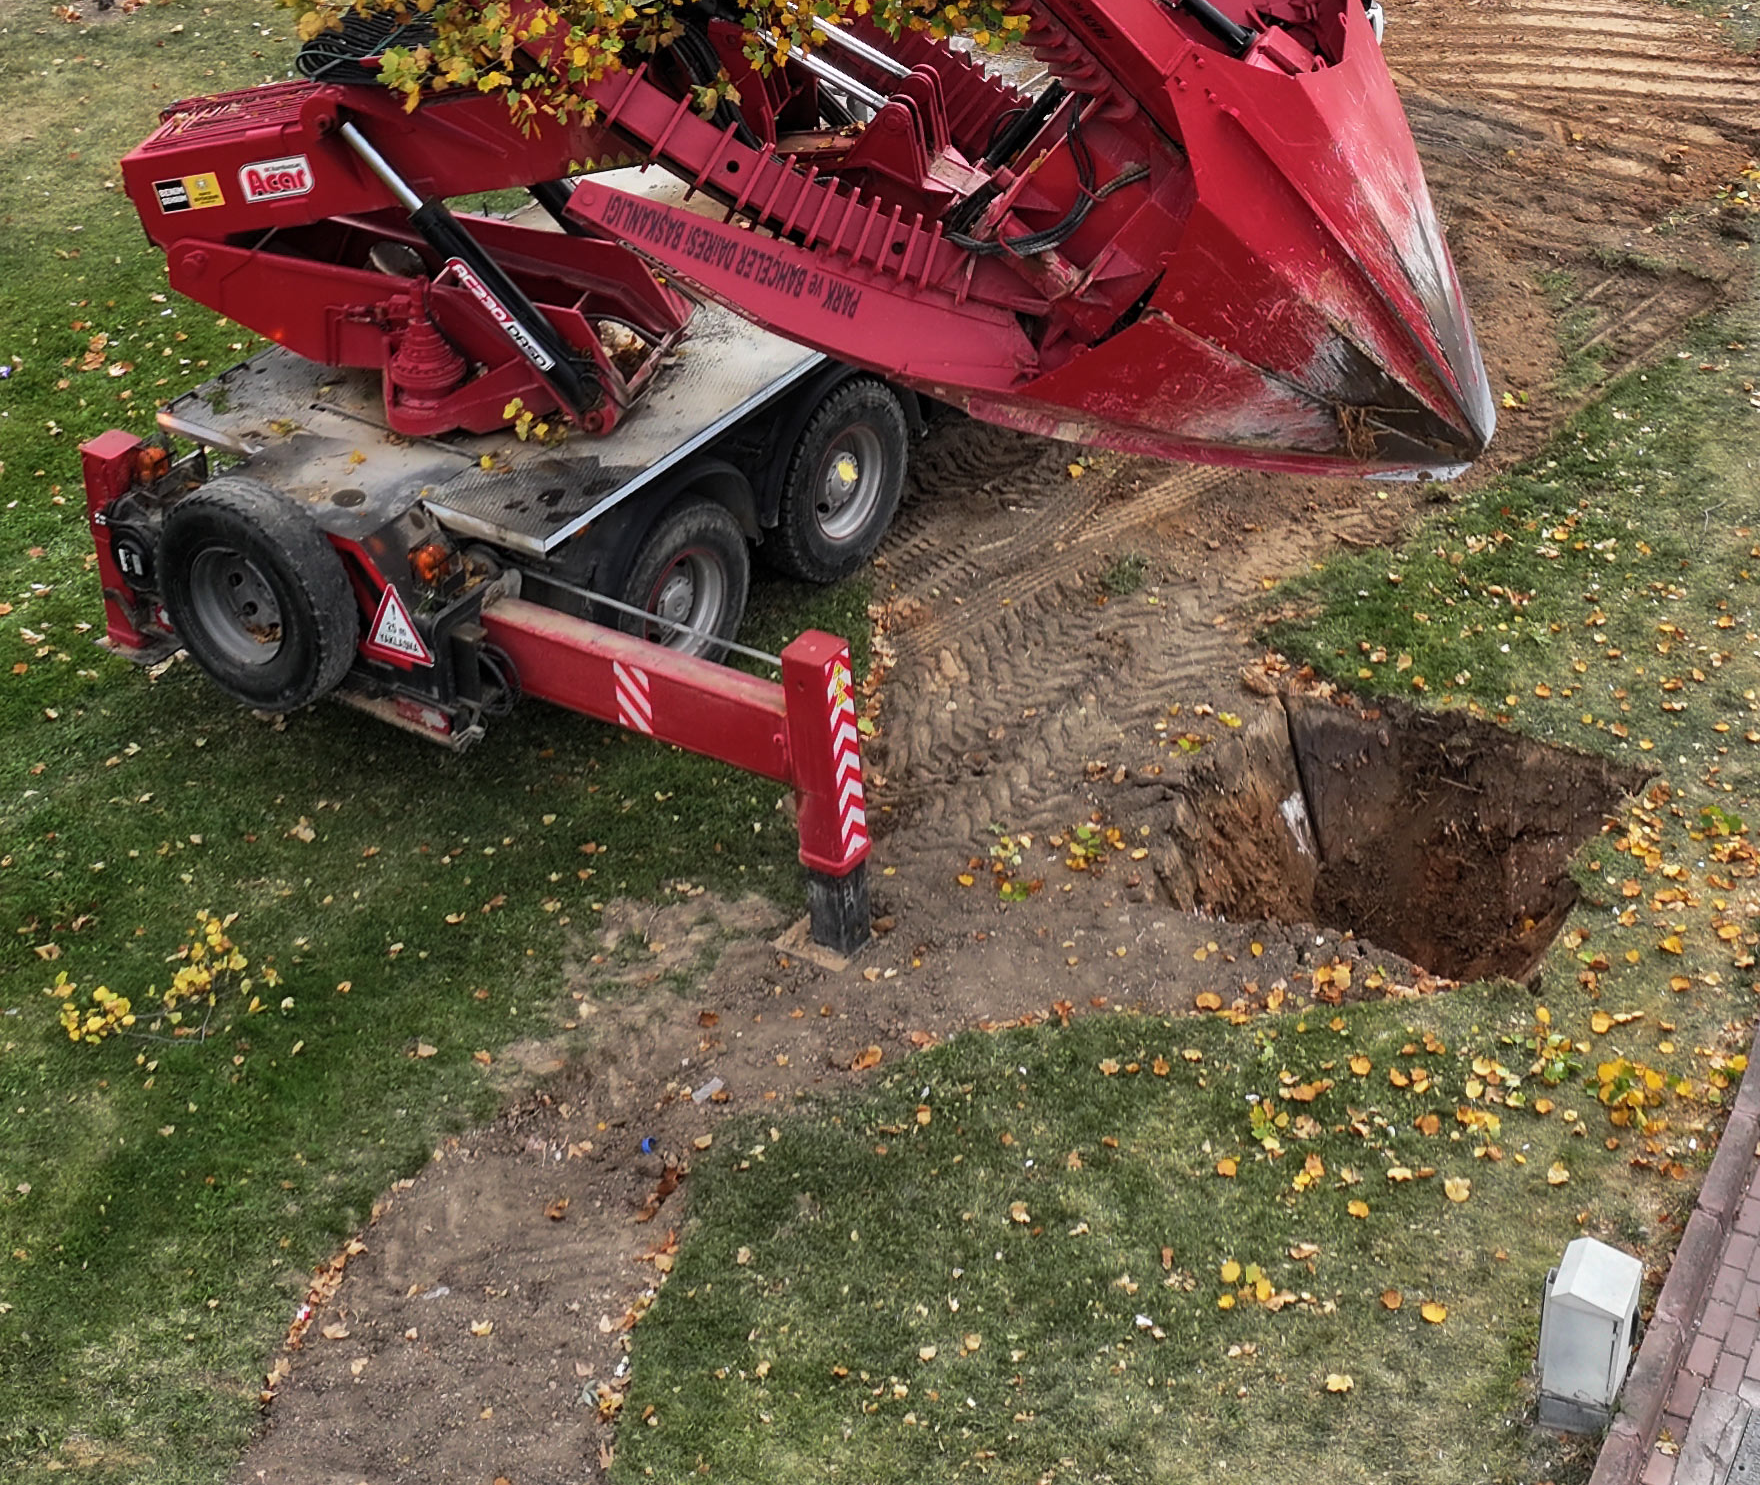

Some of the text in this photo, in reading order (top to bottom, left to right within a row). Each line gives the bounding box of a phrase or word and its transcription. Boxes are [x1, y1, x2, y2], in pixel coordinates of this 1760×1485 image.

[247, 168, 307, 197] Acar
[735, 249, 808, 298] BAHÇELER
[807, 275, 824, 297] ve
[451, 263, 547, 367] AC230 DASD
[822, 280, 863, 318] PARK
